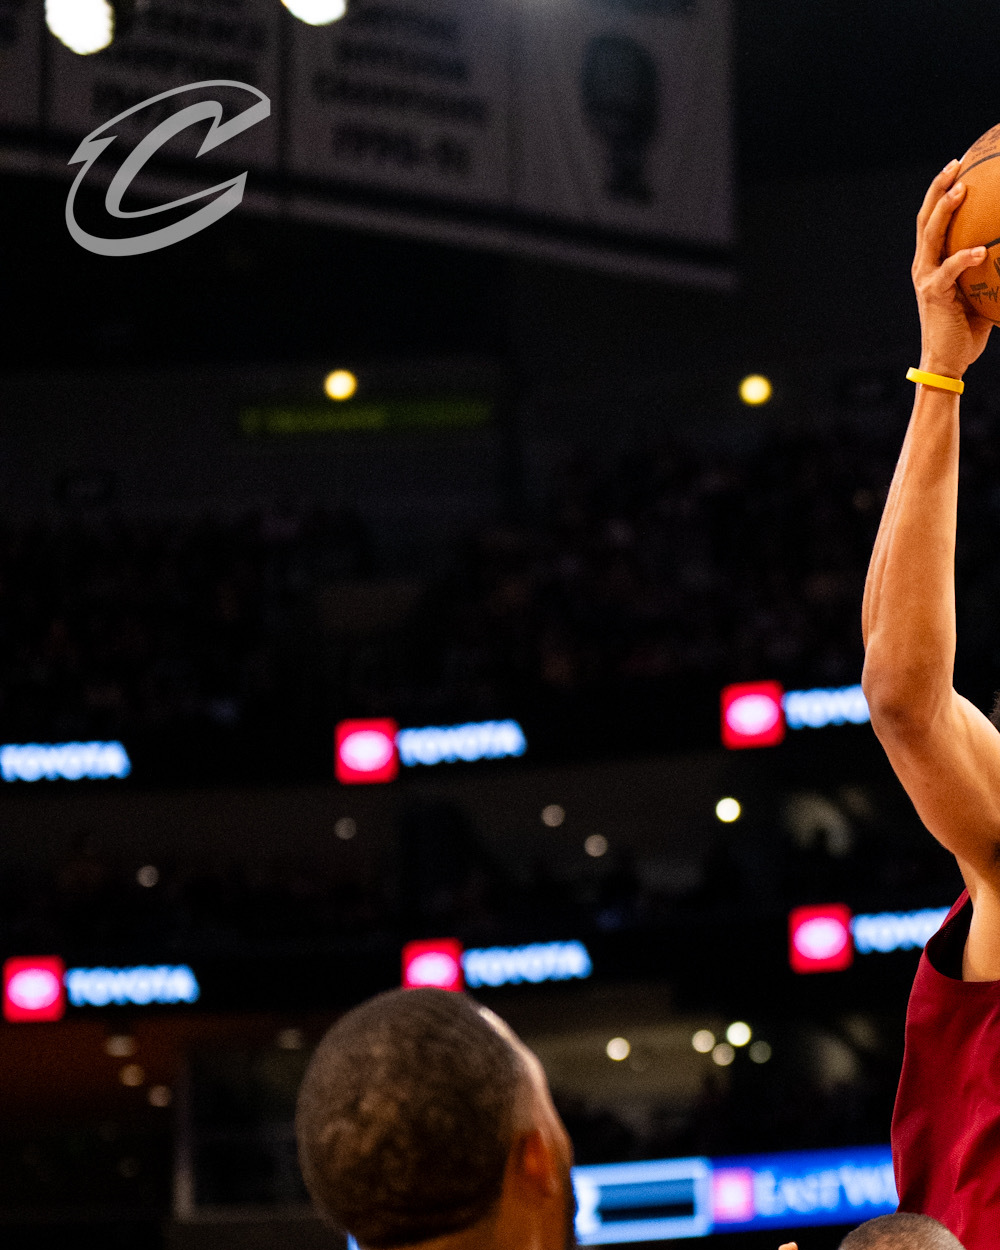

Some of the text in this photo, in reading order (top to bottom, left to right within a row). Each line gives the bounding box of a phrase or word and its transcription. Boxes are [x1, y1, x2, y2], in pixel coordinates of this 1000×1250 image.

[783, 684, 870, 729] TOYO
[397, 719, 526, 766] TOYOTA
[851, 906, 951, 954] TOYO
[64, 964, 199, 1006] TOYOTA
[462, 940, 592, 987] TOYOTA
